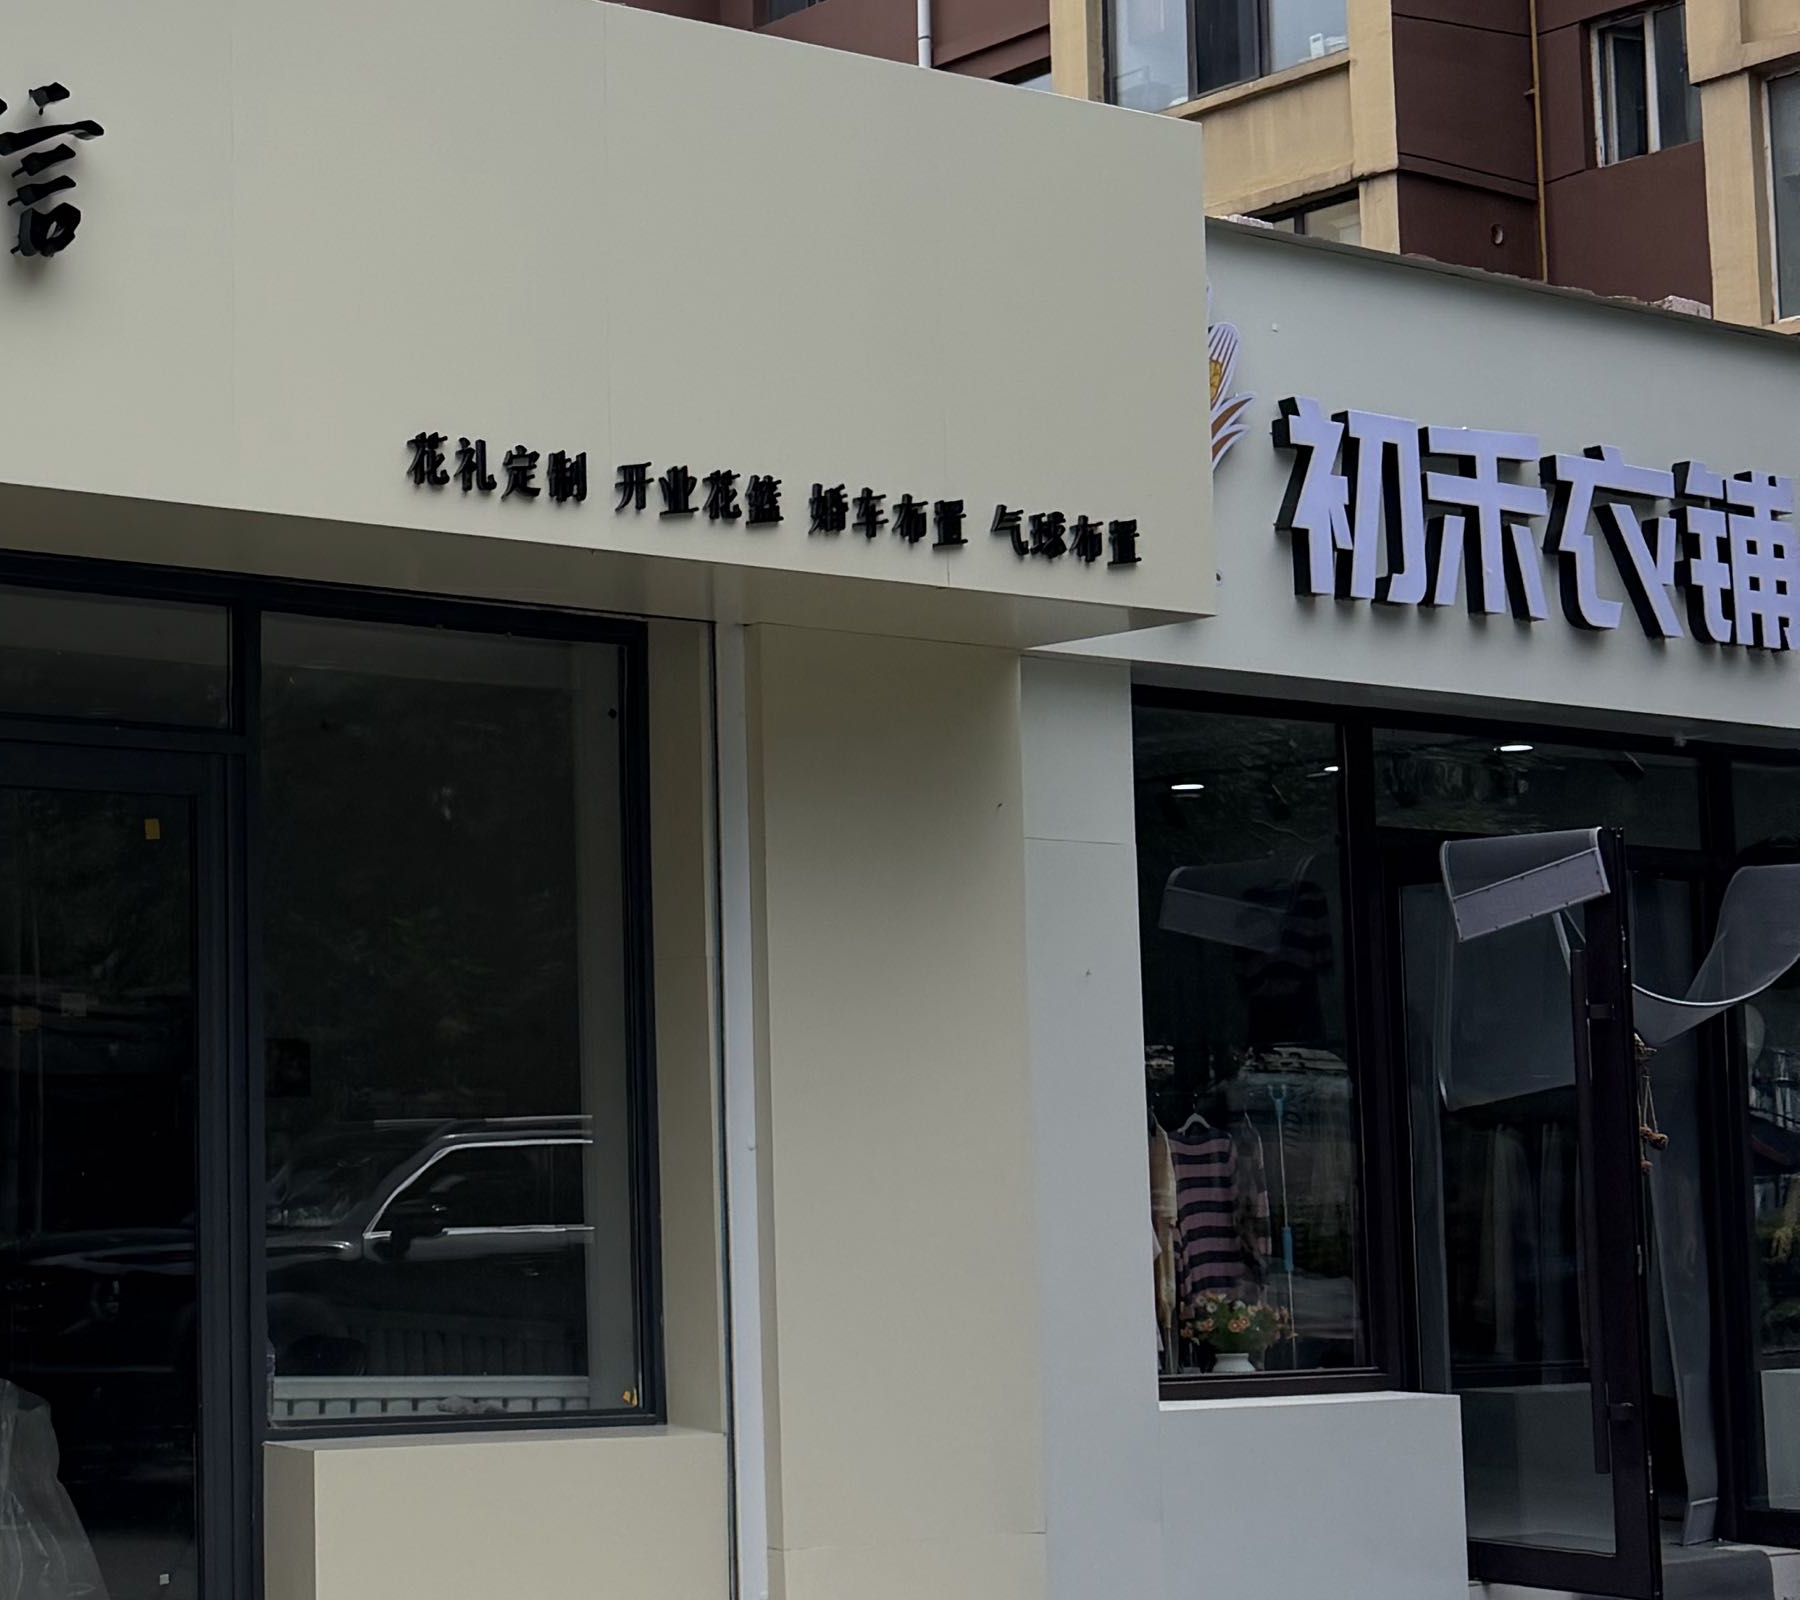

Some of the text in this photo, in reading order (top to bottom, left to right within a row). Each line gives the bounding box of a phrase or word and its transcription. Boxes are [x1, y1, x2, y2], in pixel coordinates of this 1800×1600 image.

[407, 431, 1142, 566] 花礼定制 开业花篮 婚车布置 气球布置
[1273, 396, 1799, 650] 初禾衣铺
